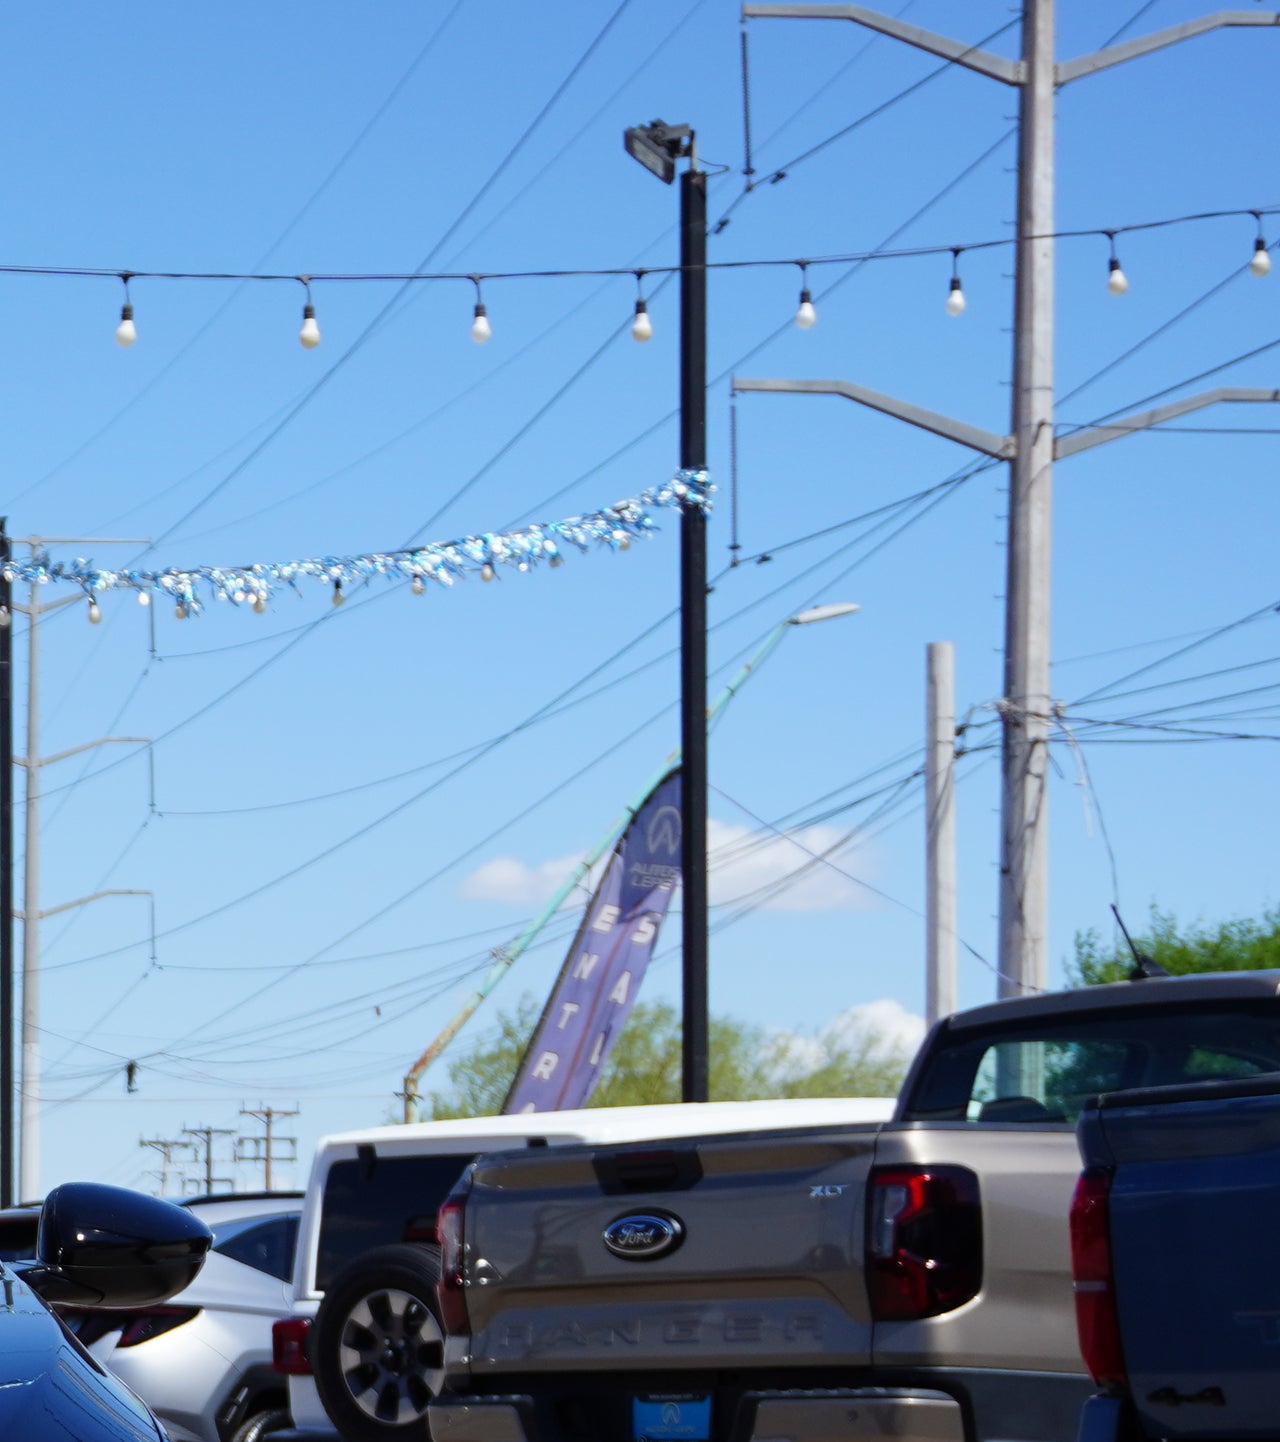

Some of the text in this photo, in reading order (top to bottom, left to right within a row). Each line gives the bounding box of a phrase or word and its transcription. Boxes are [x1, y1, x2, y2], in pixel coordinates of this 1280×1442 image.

[809, 1184, 849, 1198] XLT
[618, 1223, 655, 1246] Ford
[500, 1312, 825, 1347] RANGER
